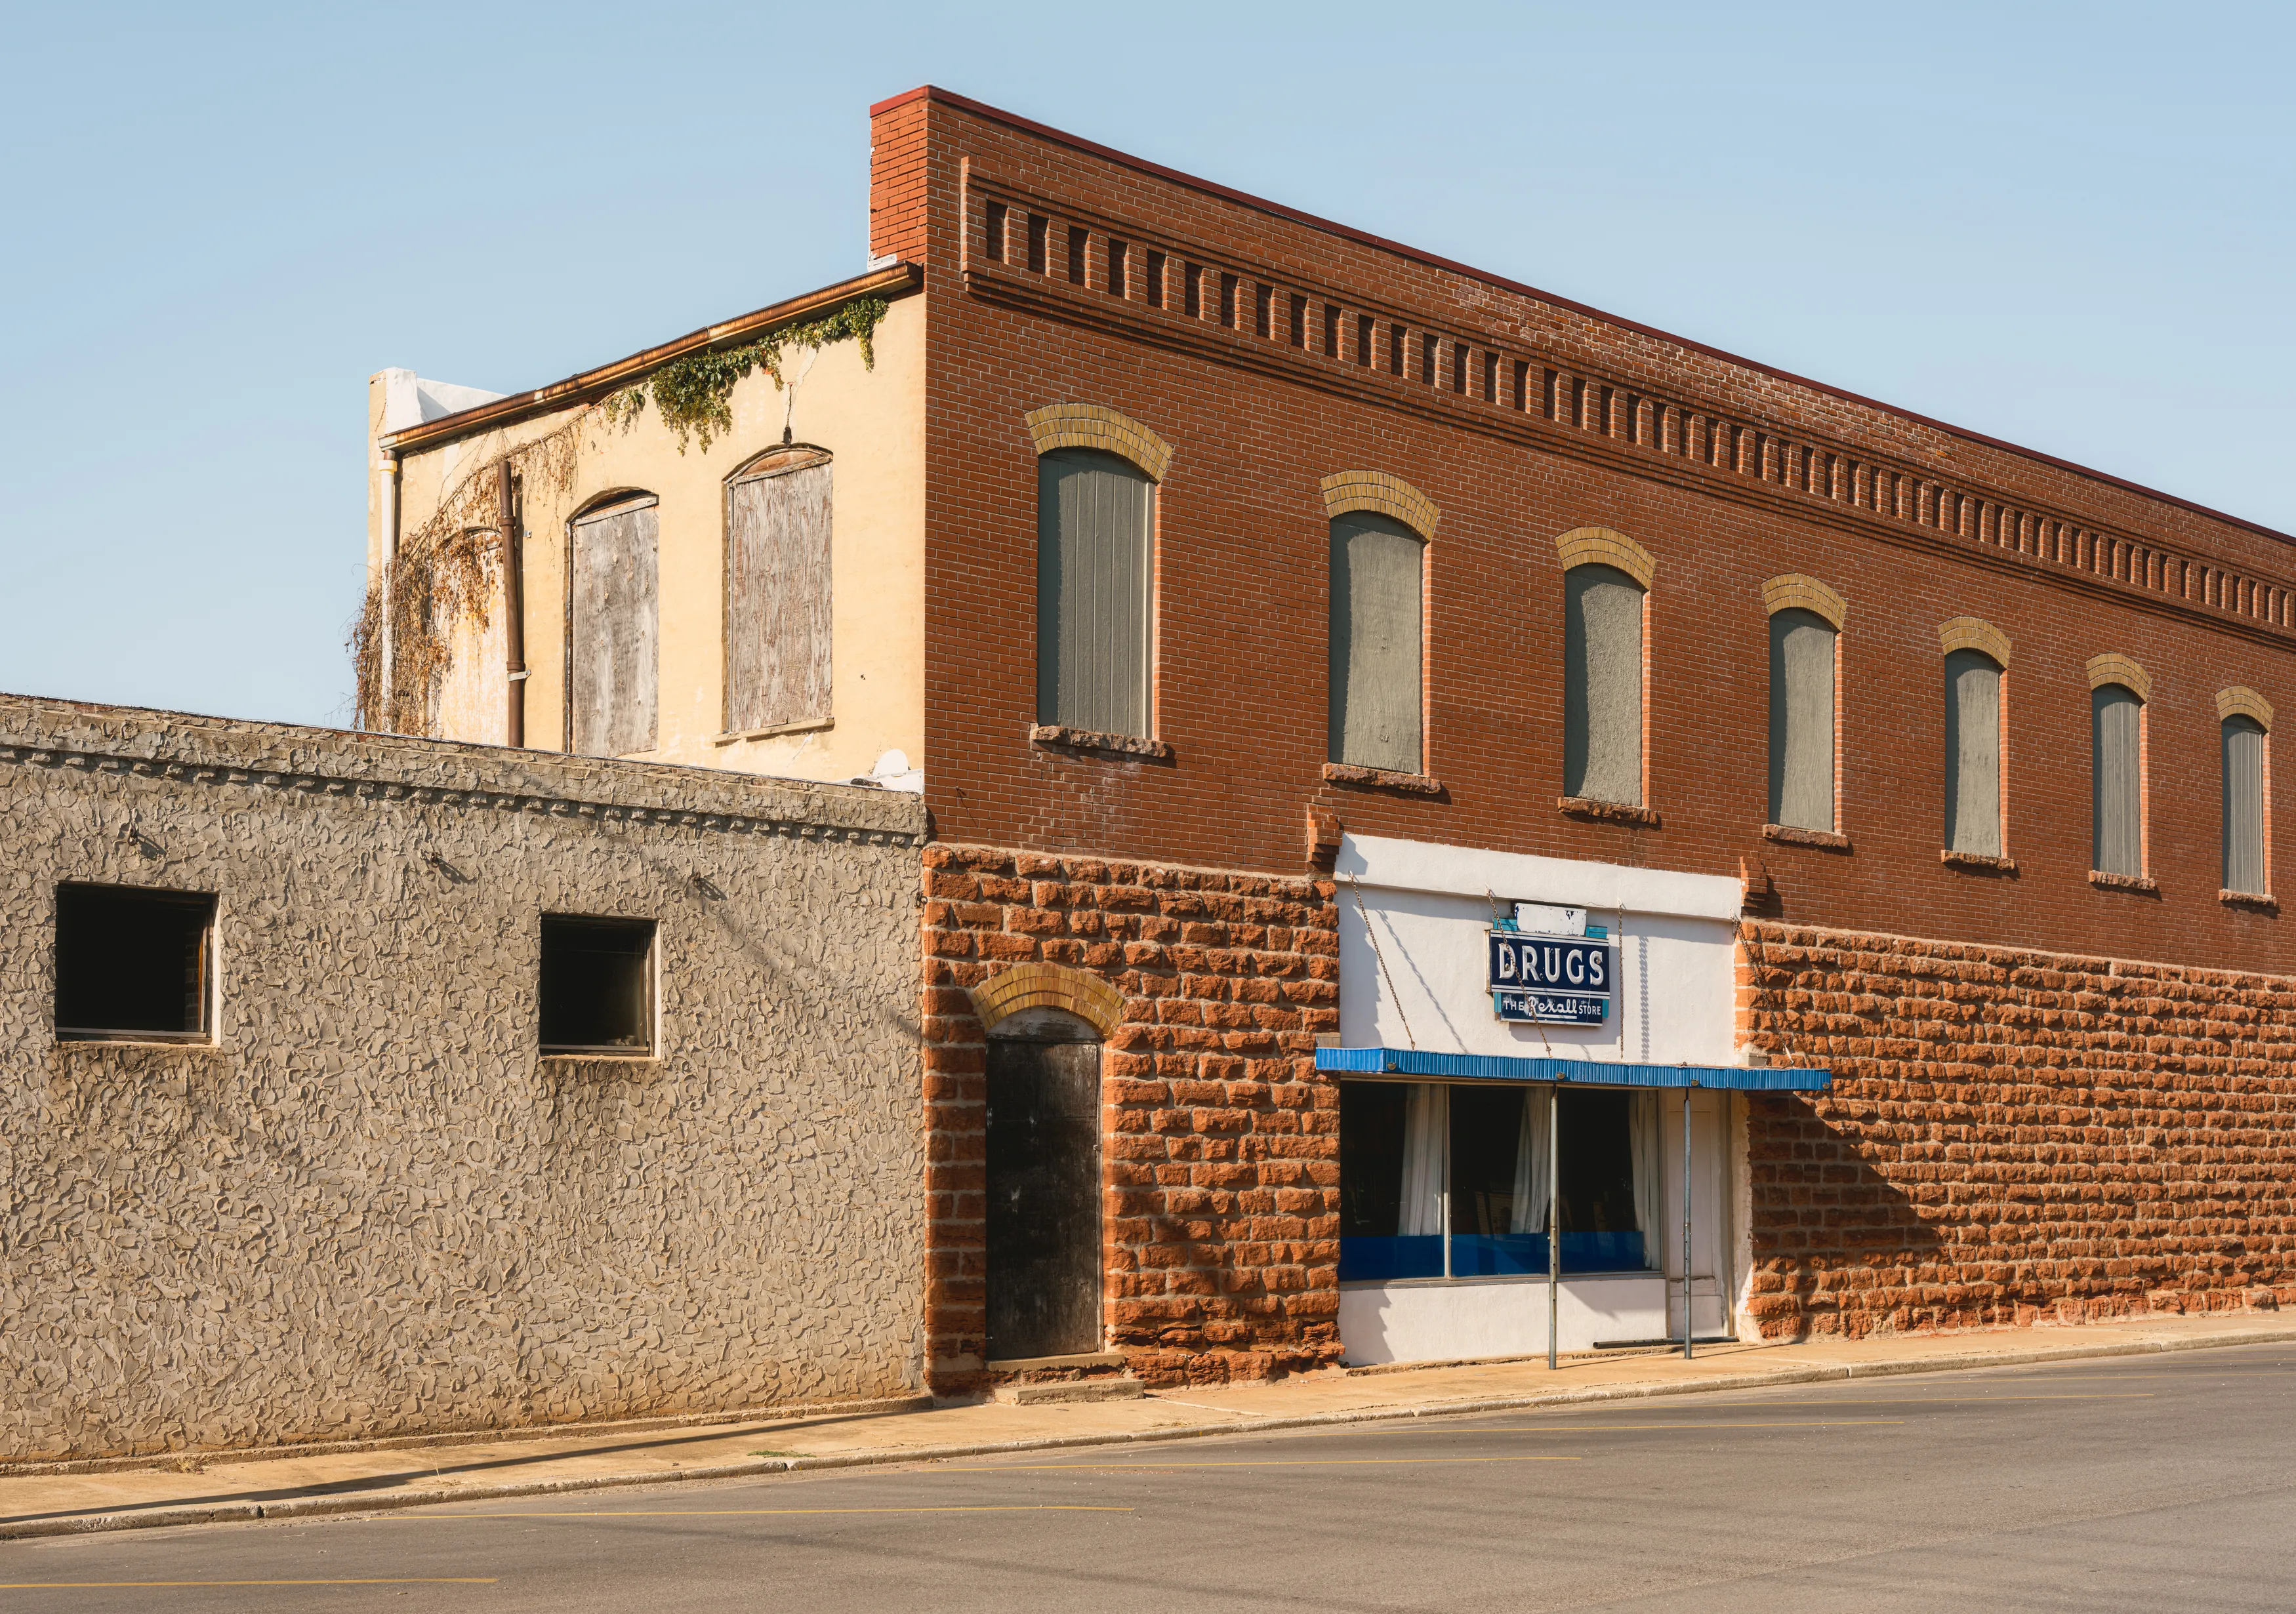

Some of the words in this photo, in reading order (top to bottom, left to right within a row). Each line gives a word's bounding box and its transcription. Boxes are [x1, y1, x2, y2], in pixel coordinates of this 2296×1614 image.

[1498, 943, 1604, 986] DRUGS
[1504, 1000, 1524, 1011] THE
[1527, 996, 1577, 1016] Rexall
[1579, 1005, 1601, 1015] STORE
